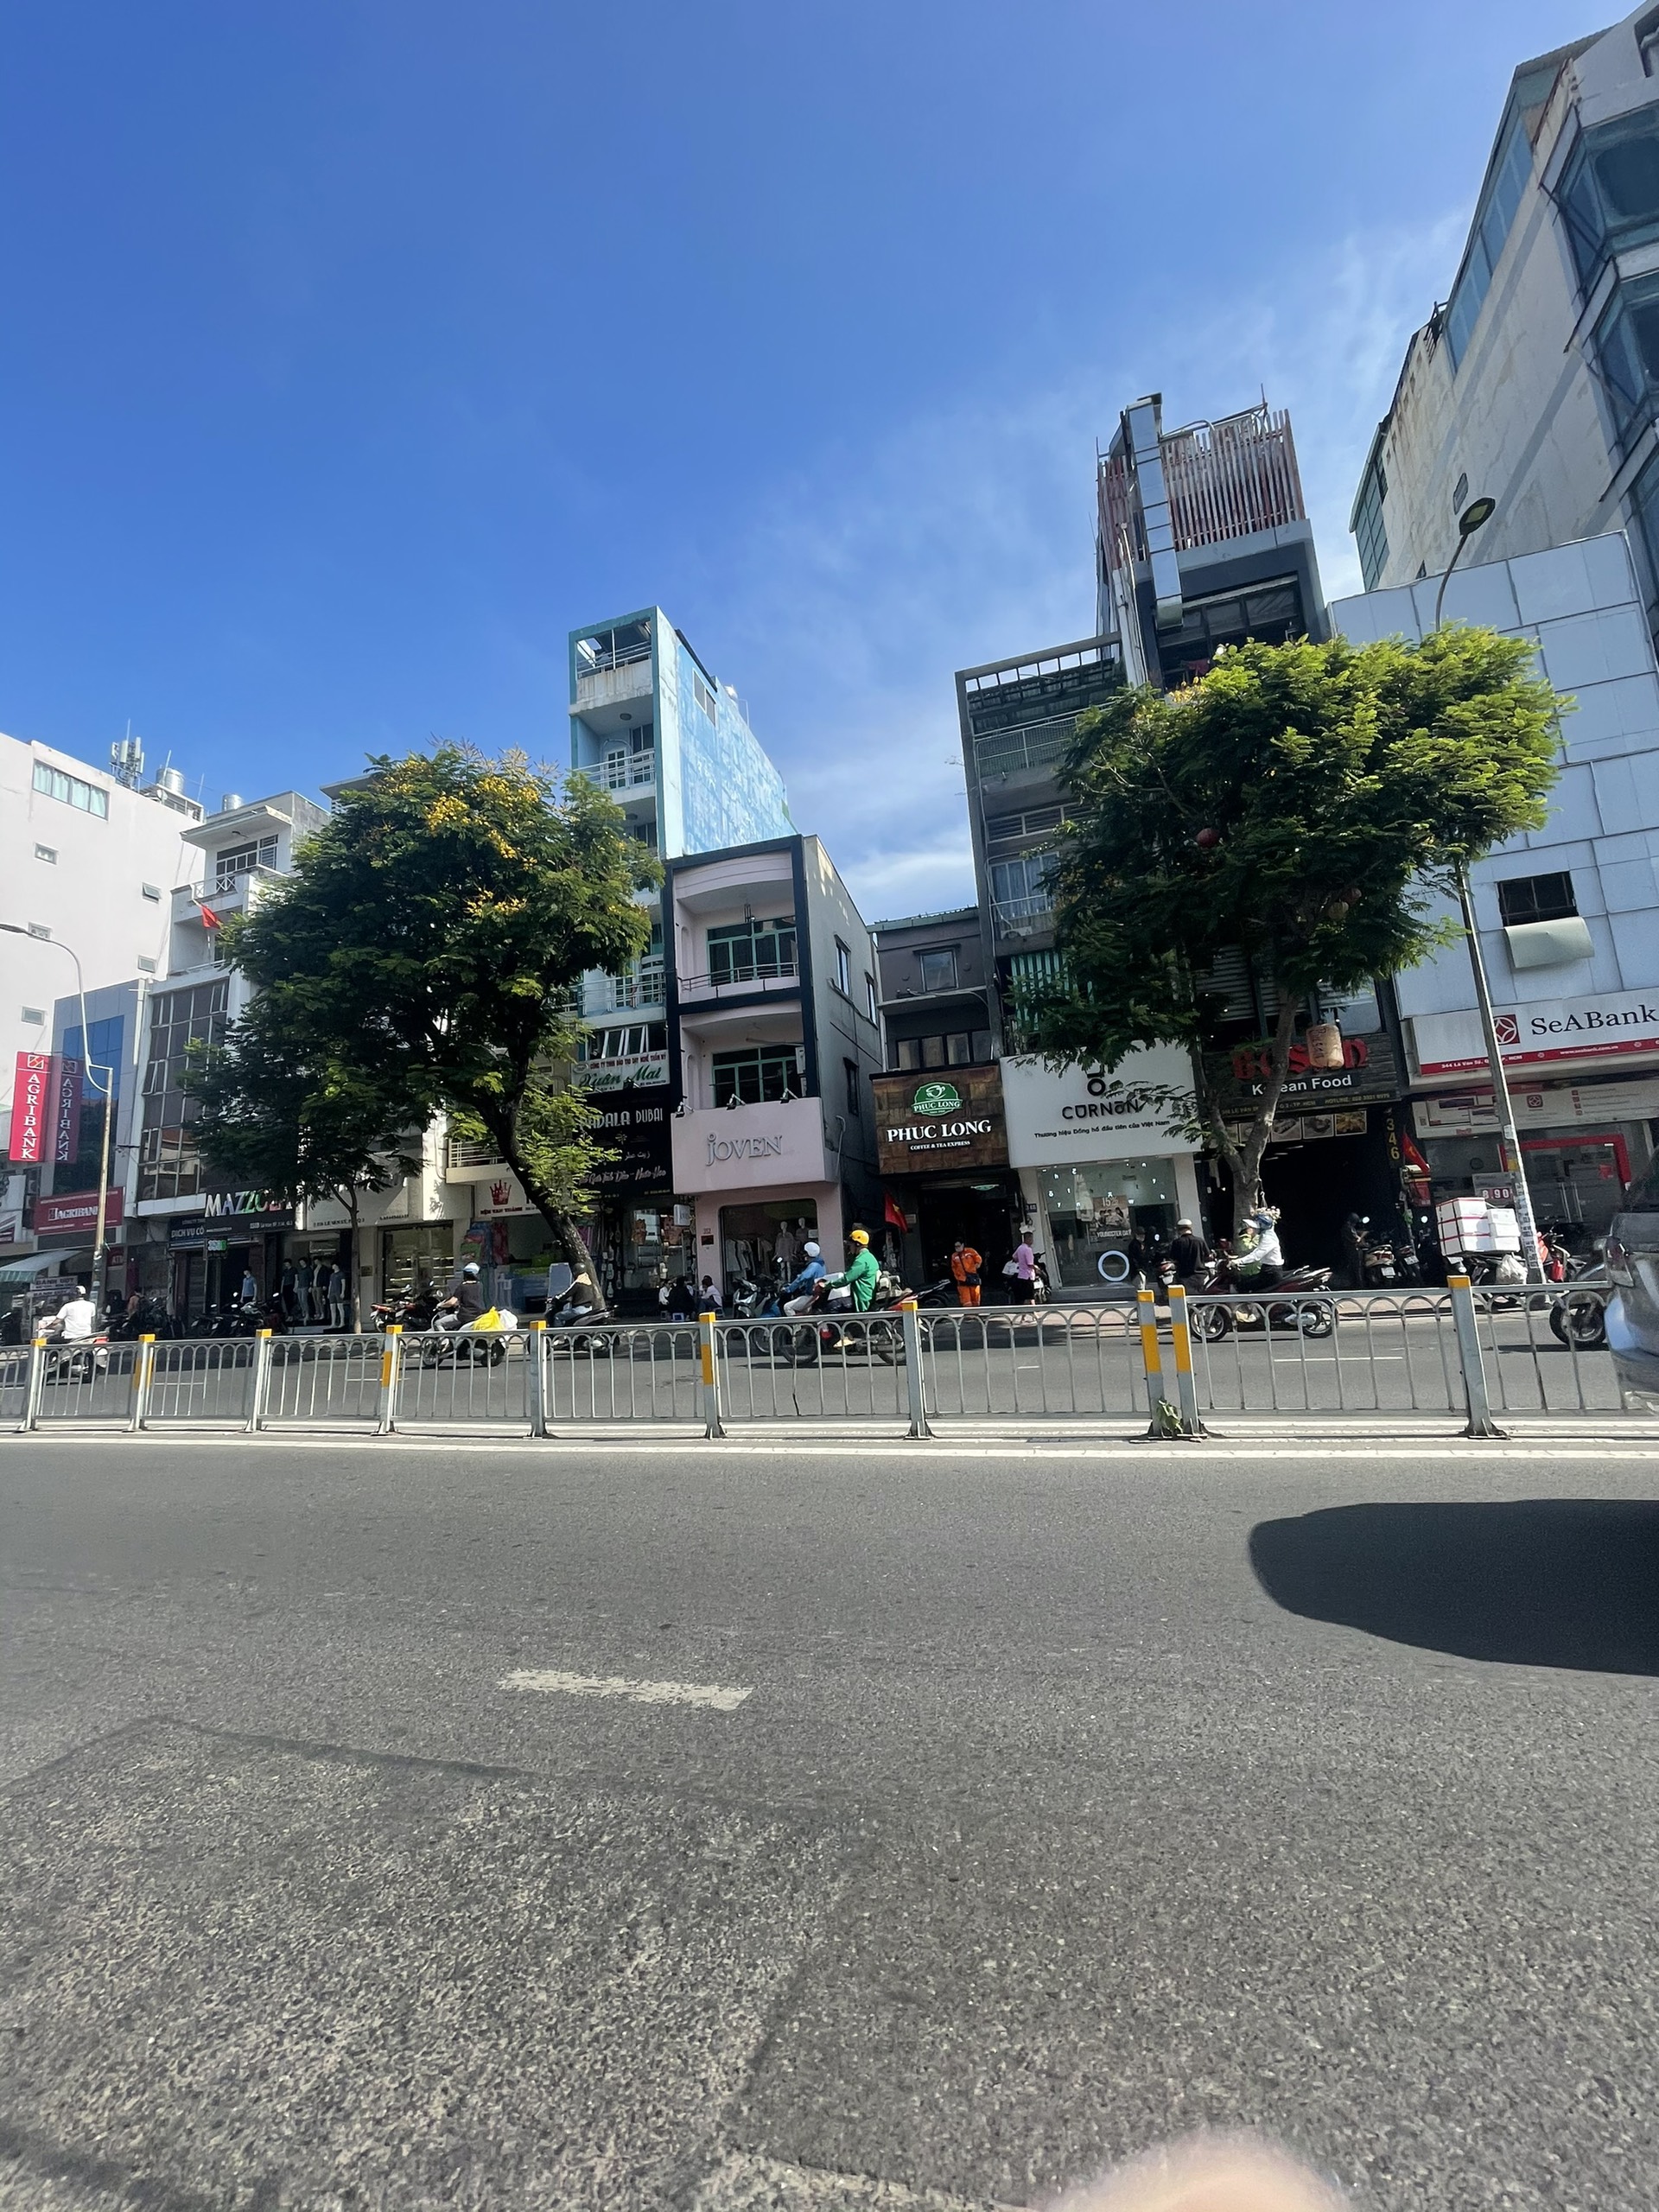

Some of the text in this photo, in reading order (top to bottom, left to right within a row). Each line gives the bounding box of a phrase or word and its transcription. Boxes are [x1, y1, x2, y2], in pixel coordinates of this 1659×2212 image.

[1530, 1004, 1658, 1036] SeABank
[1252, 1075, 1352, 1096] Kean Food
[21, 1072, 41, 1160] AGRIBANK
[635, 1108, 664, 1123] DUBAI
[940, 1119, 993, 1138] LONG
[1386, 1118, 1401, 1160] 346
